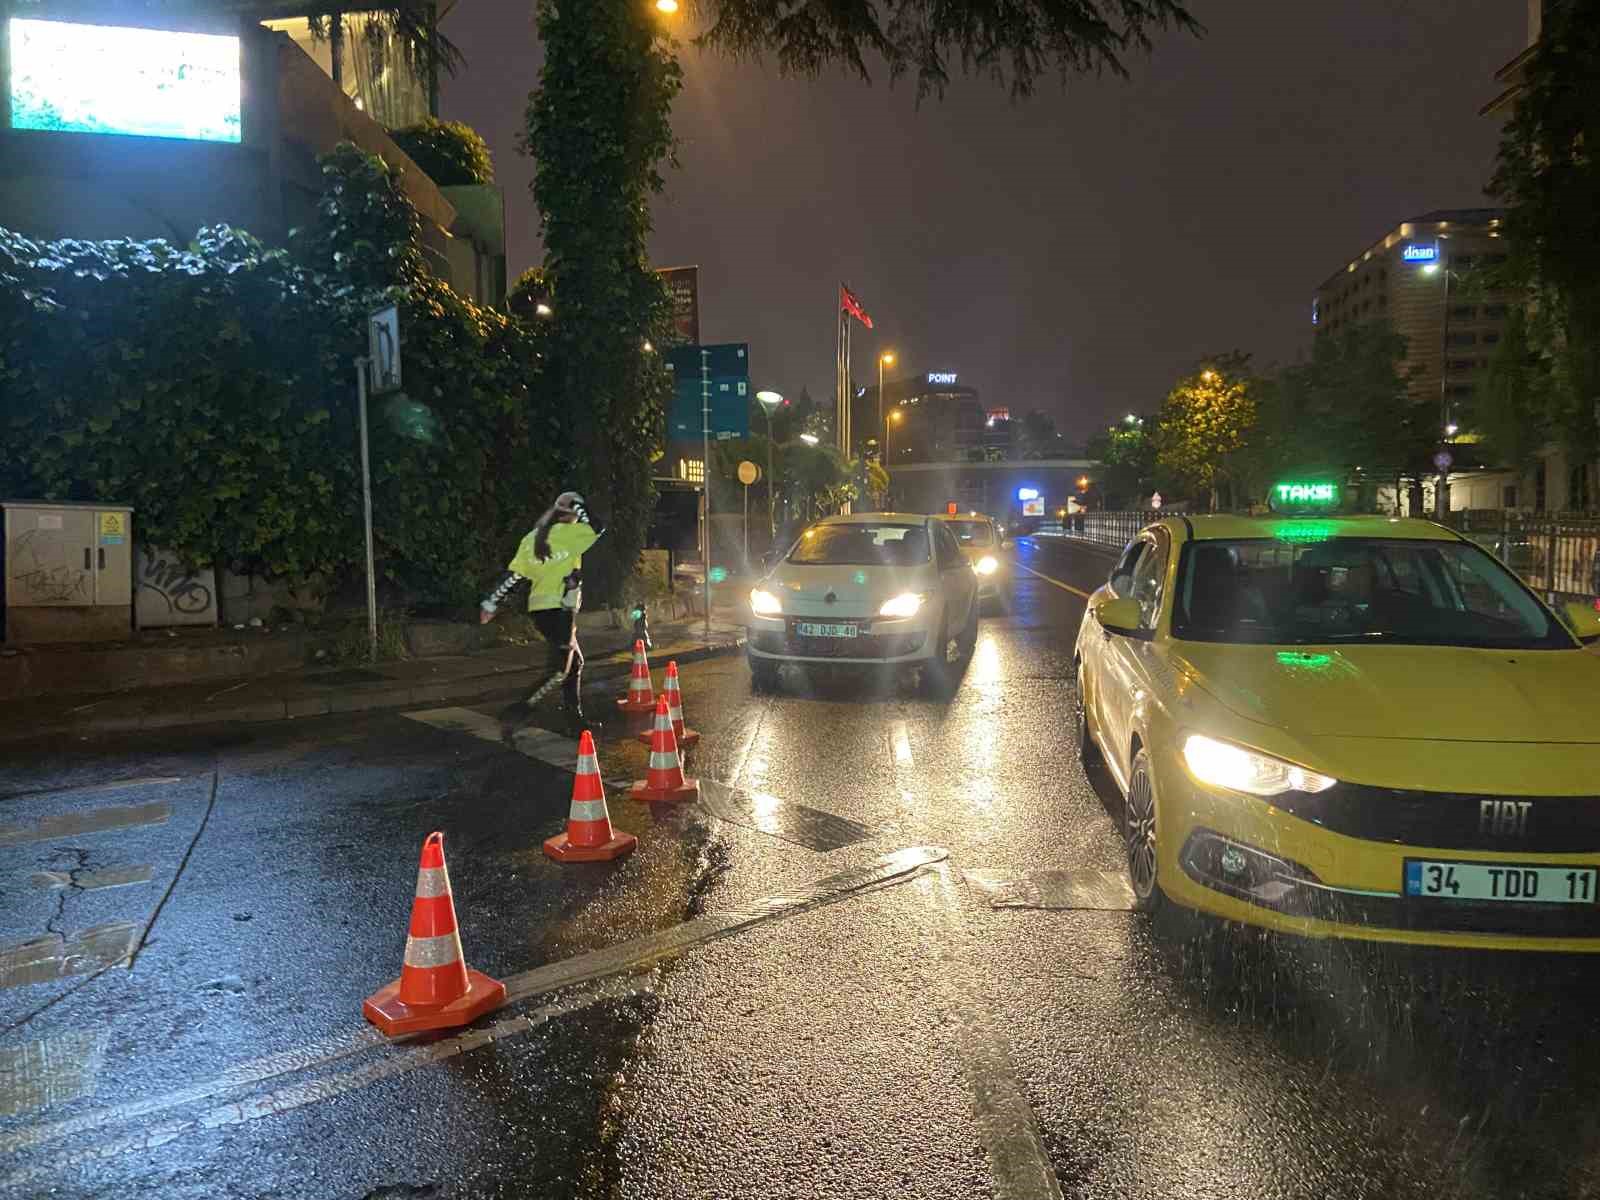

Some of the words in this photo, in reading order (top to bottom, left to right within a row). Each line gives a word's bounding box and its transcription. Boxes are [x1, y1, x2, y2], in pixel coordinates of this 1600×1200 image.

[928, 373, 957, 384] POINT
[1479, 800, 1533, 836] FIAT
[1426, 865, 1460, 895] 34
[1487, 868, 1539, 898] TDD
[1565, 871, 1592, 900] 11
